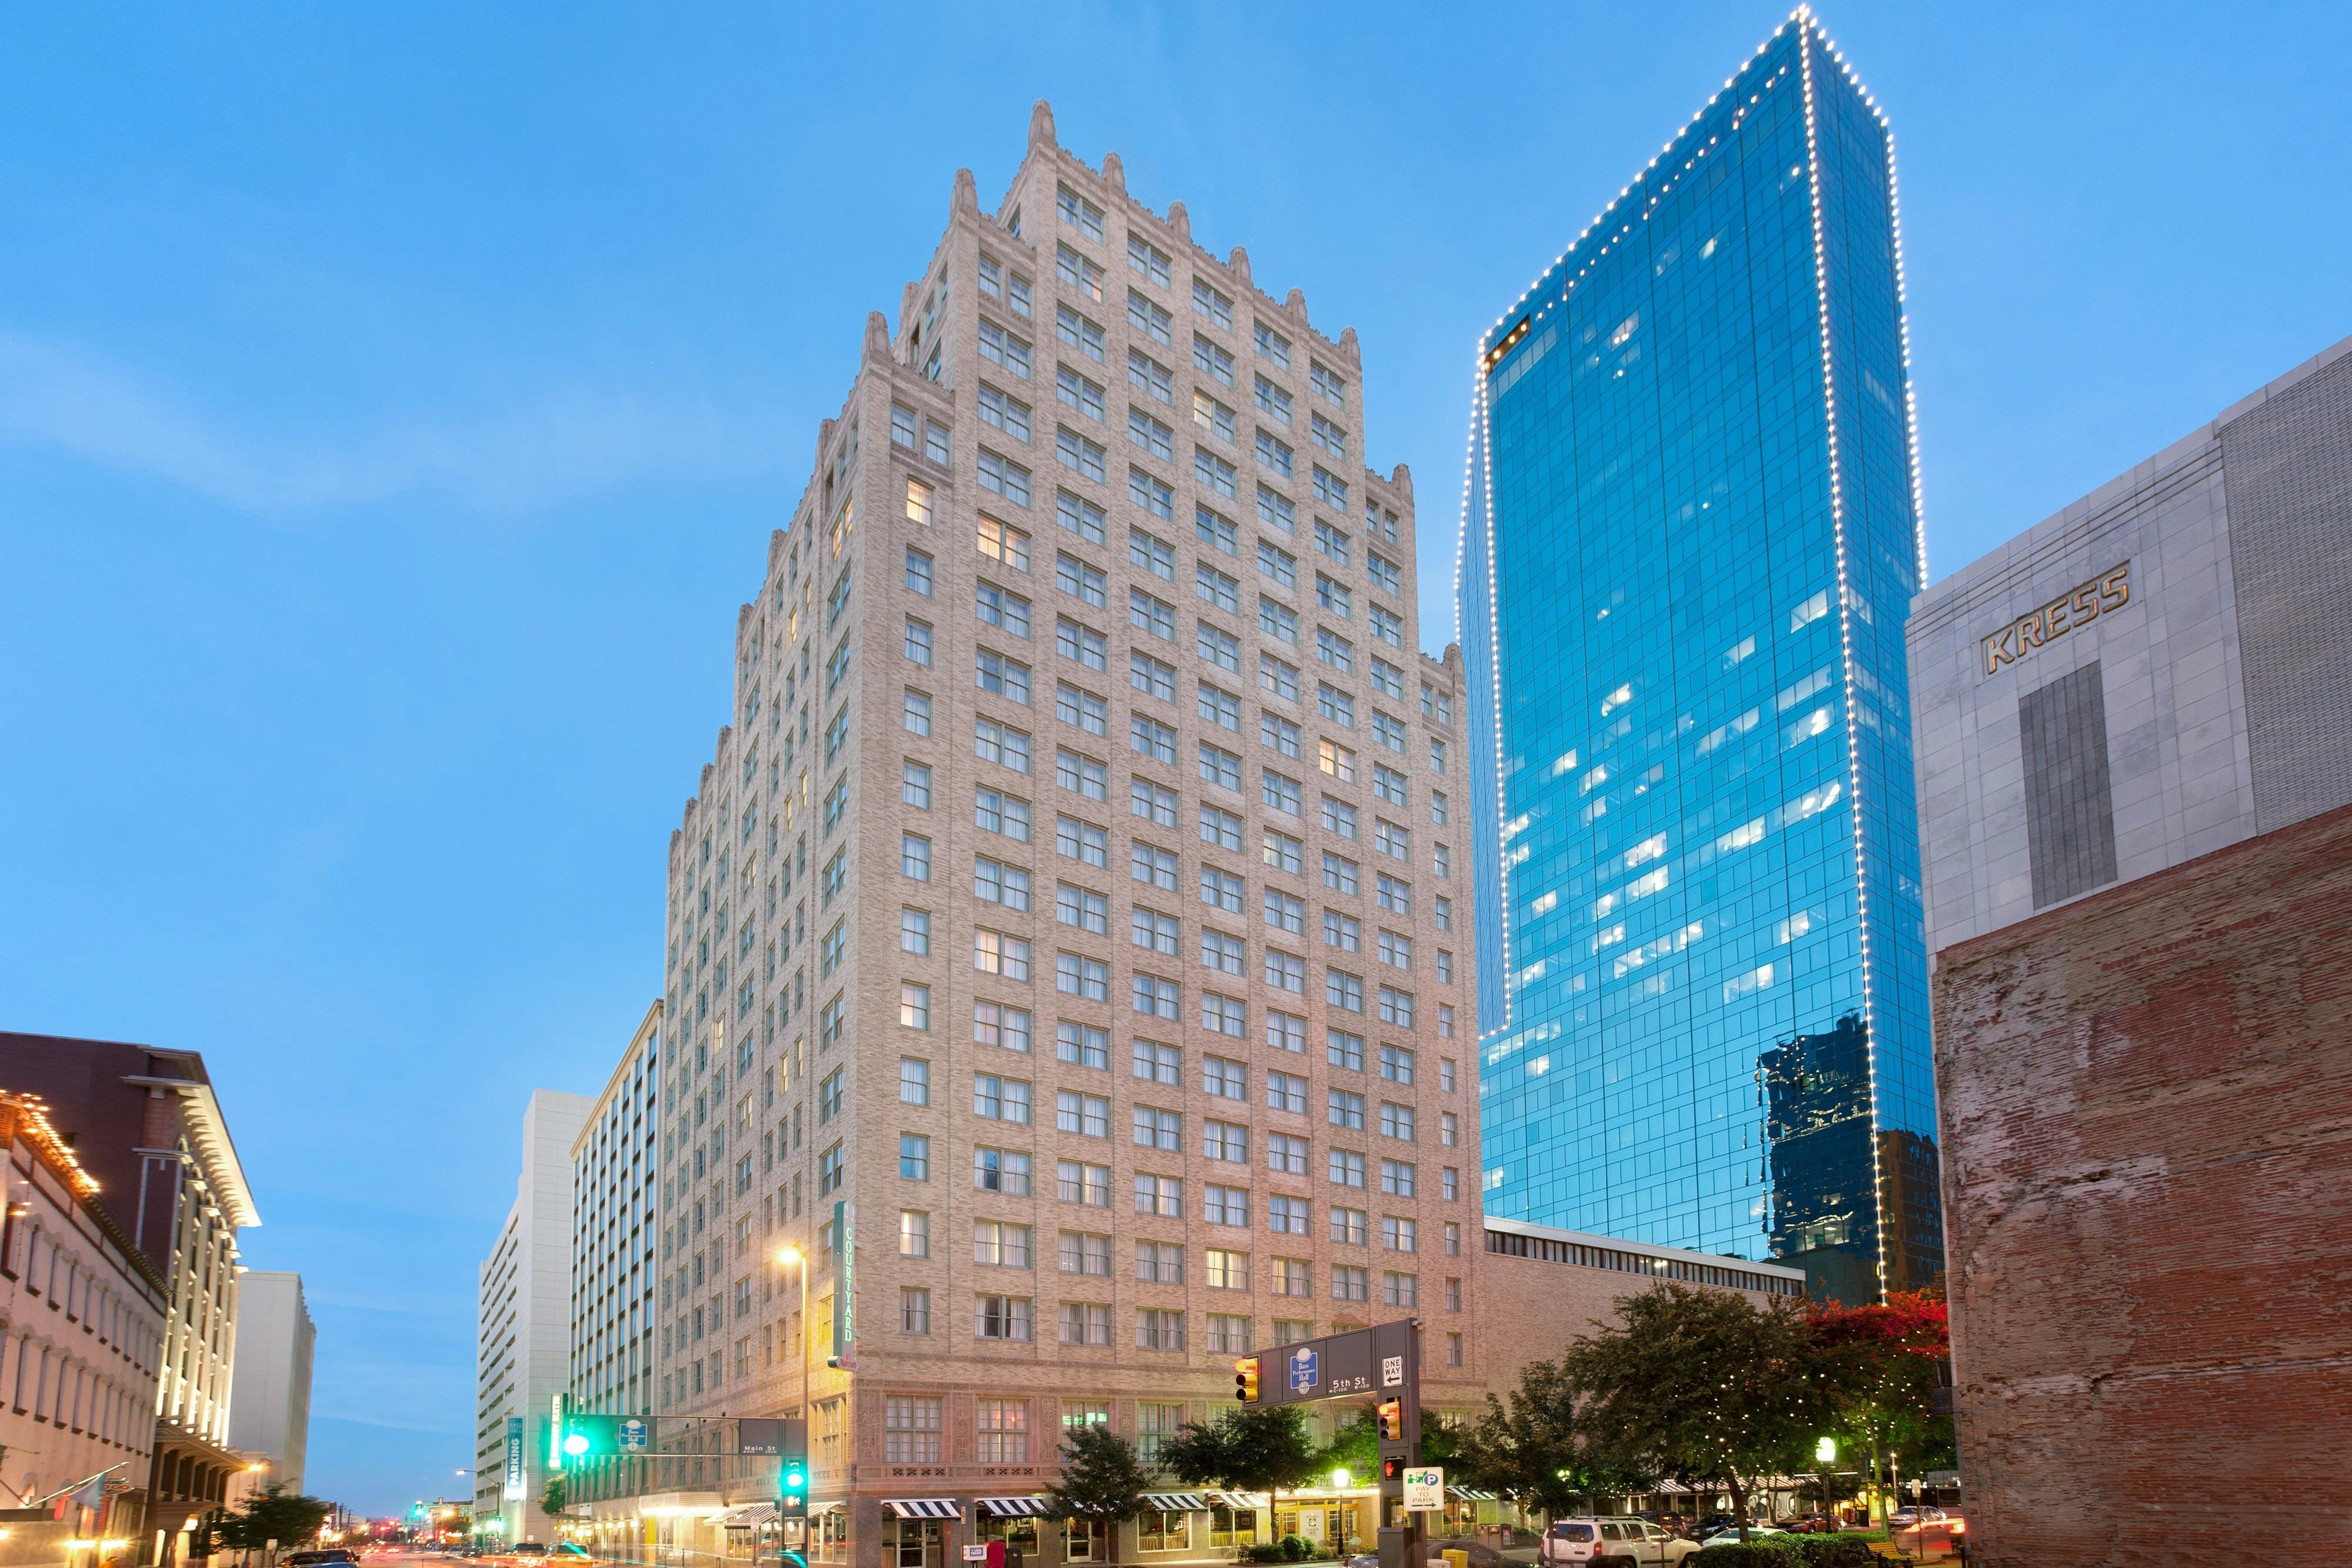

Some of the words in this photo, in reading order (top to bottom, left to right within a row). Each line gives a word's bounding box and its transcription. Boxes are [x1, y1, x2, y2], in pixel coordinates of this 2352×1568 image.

[1986, 569, 2129, 675] KRESS
[838, 1358, 856, 1369] Marriott
[1385, 1359, 1400, 1368] ONE
[1385, 1367, 1400, 1376] WAY
[1333, 1379, 1351, 1388] 5th
[1355, 1376, 1365, 1385] St
[510, 1438, 520, 1486] PARKING
